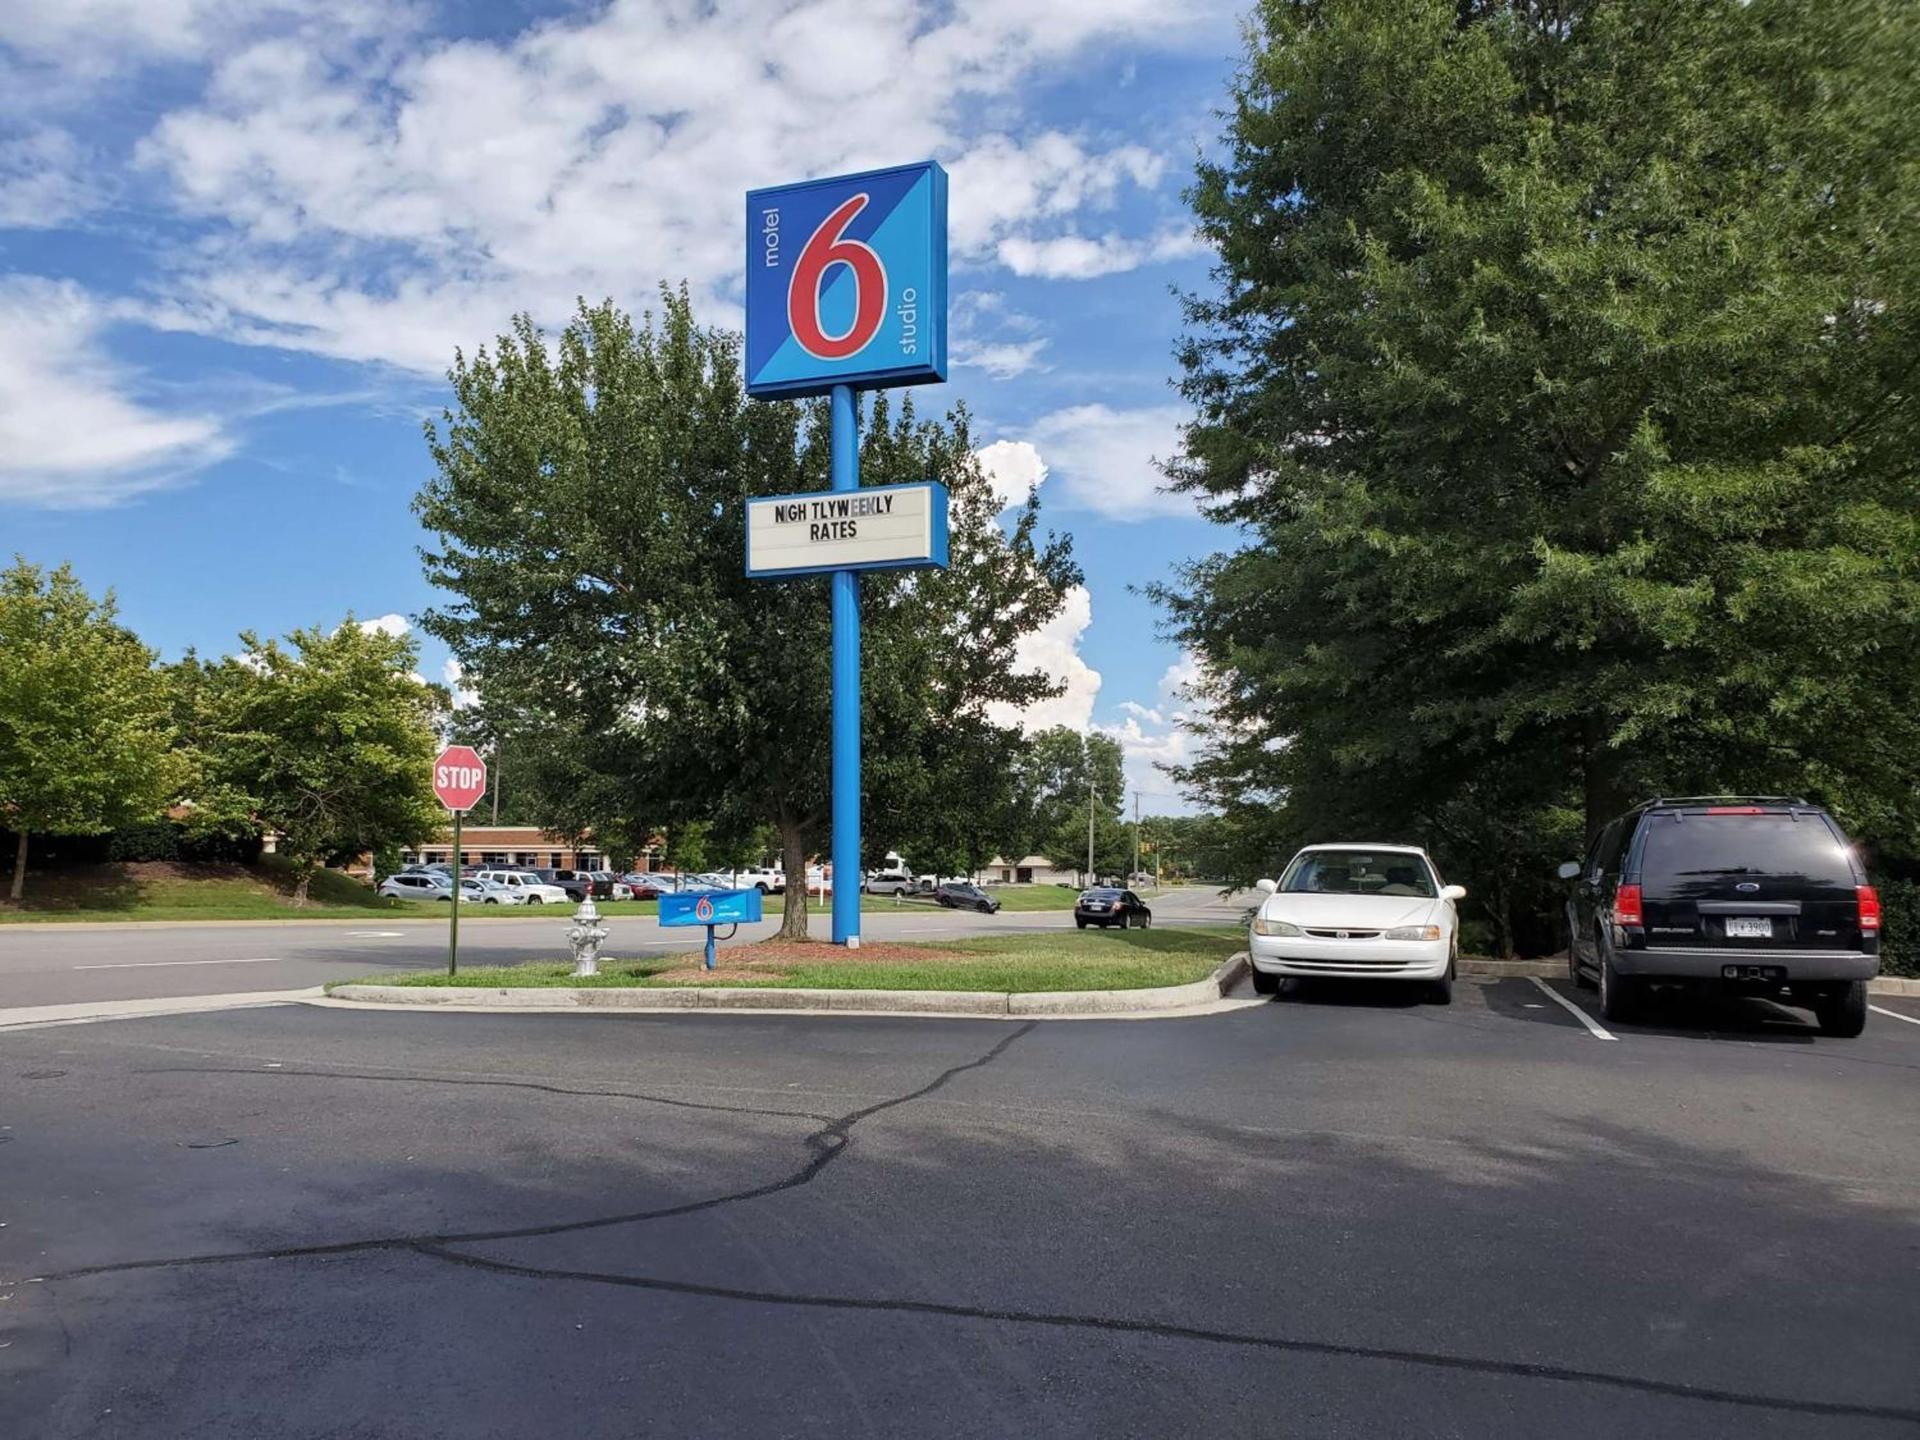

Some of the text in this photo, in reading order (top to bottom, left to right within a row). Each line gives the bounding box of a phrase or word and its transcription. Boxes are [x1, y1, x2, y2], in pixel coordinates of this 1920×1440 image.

[762, 208, 779, 267] motel
[787, 193, 888, 361] 6
[897, 287, 916, 354] studio
[810, 520, 857, 540] RATES
[437, 765, 482, 789] STOP
[696, 895, 713, 921] 6
